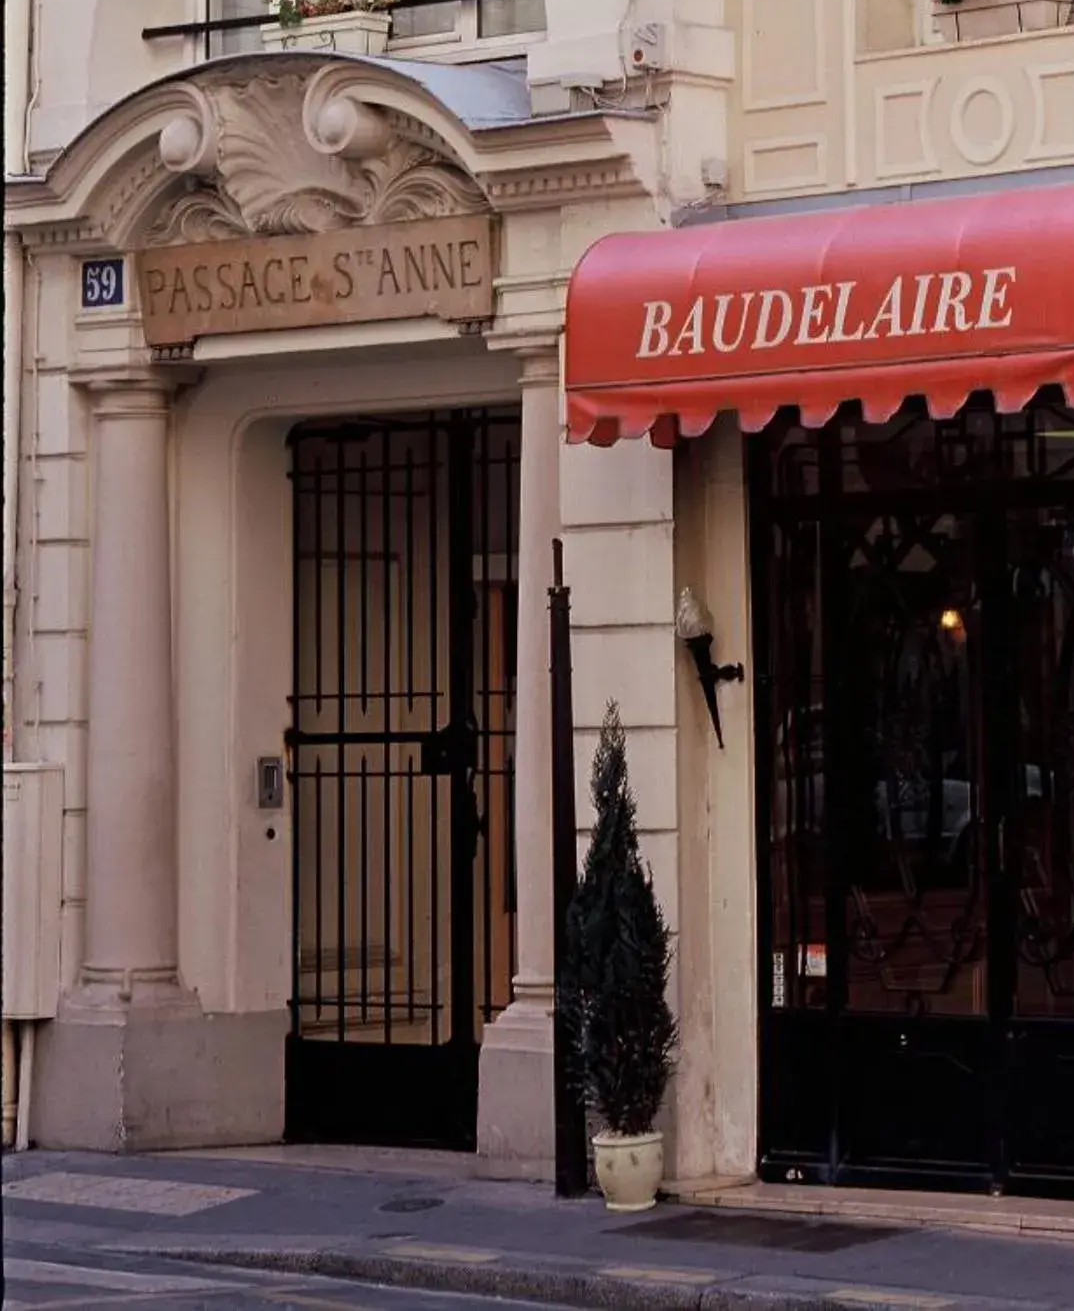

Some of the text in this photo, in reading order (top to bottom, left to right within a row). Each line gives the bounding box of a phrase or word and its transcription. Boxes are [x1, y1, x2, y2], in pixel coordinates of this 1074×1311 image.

[86, 265, 117, 301] 59
[144, 254, 312, 316] PASSAGE
[377, 240, 483, 296] ANNE
[635, 266, 1017, 359] BAUDELAIRE
